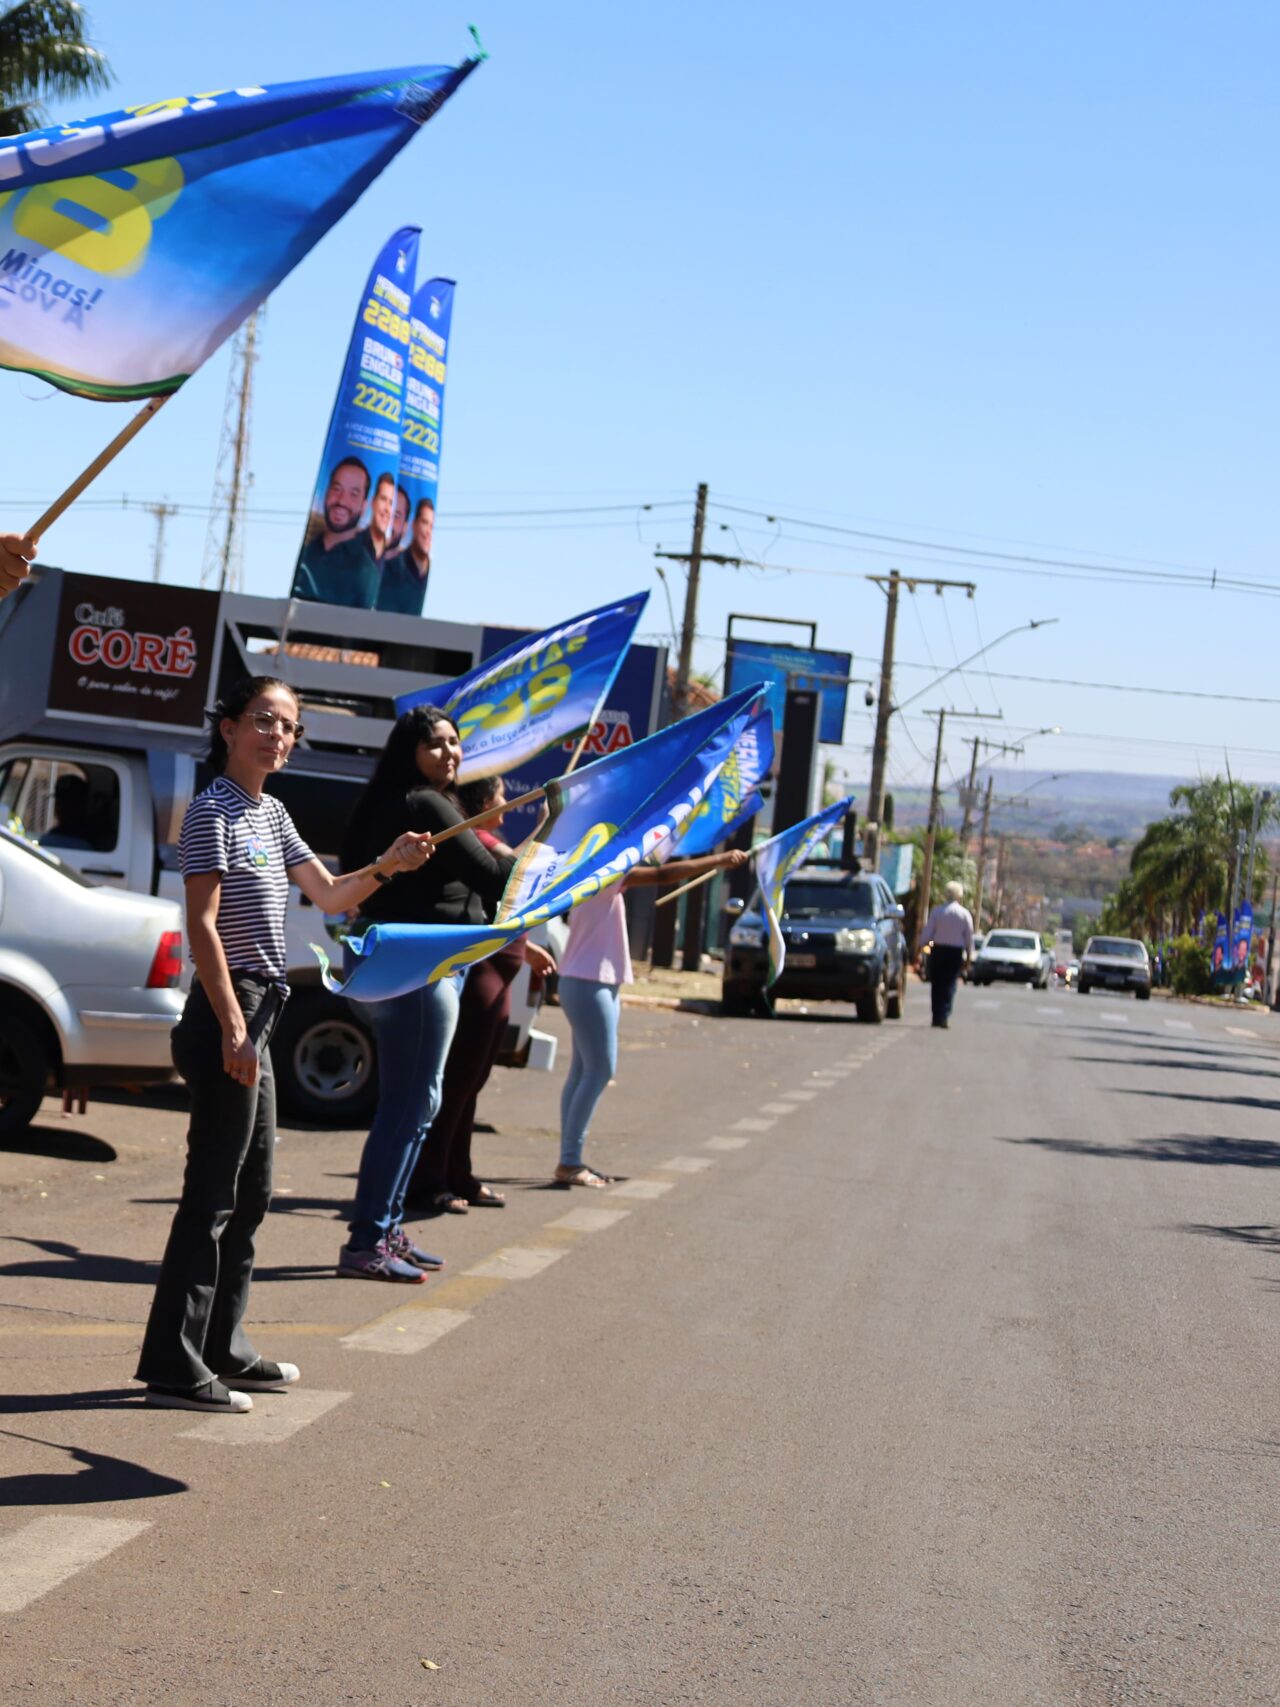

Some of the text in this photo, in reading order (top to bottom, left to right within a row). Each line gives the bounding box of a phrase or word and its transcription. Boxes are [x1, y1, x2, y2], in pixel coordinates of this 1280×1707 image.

[363, 298, 411, 346] 2288
[74, 603, 126, 628] Café
[68, 626, 198, 678] CORÉ
